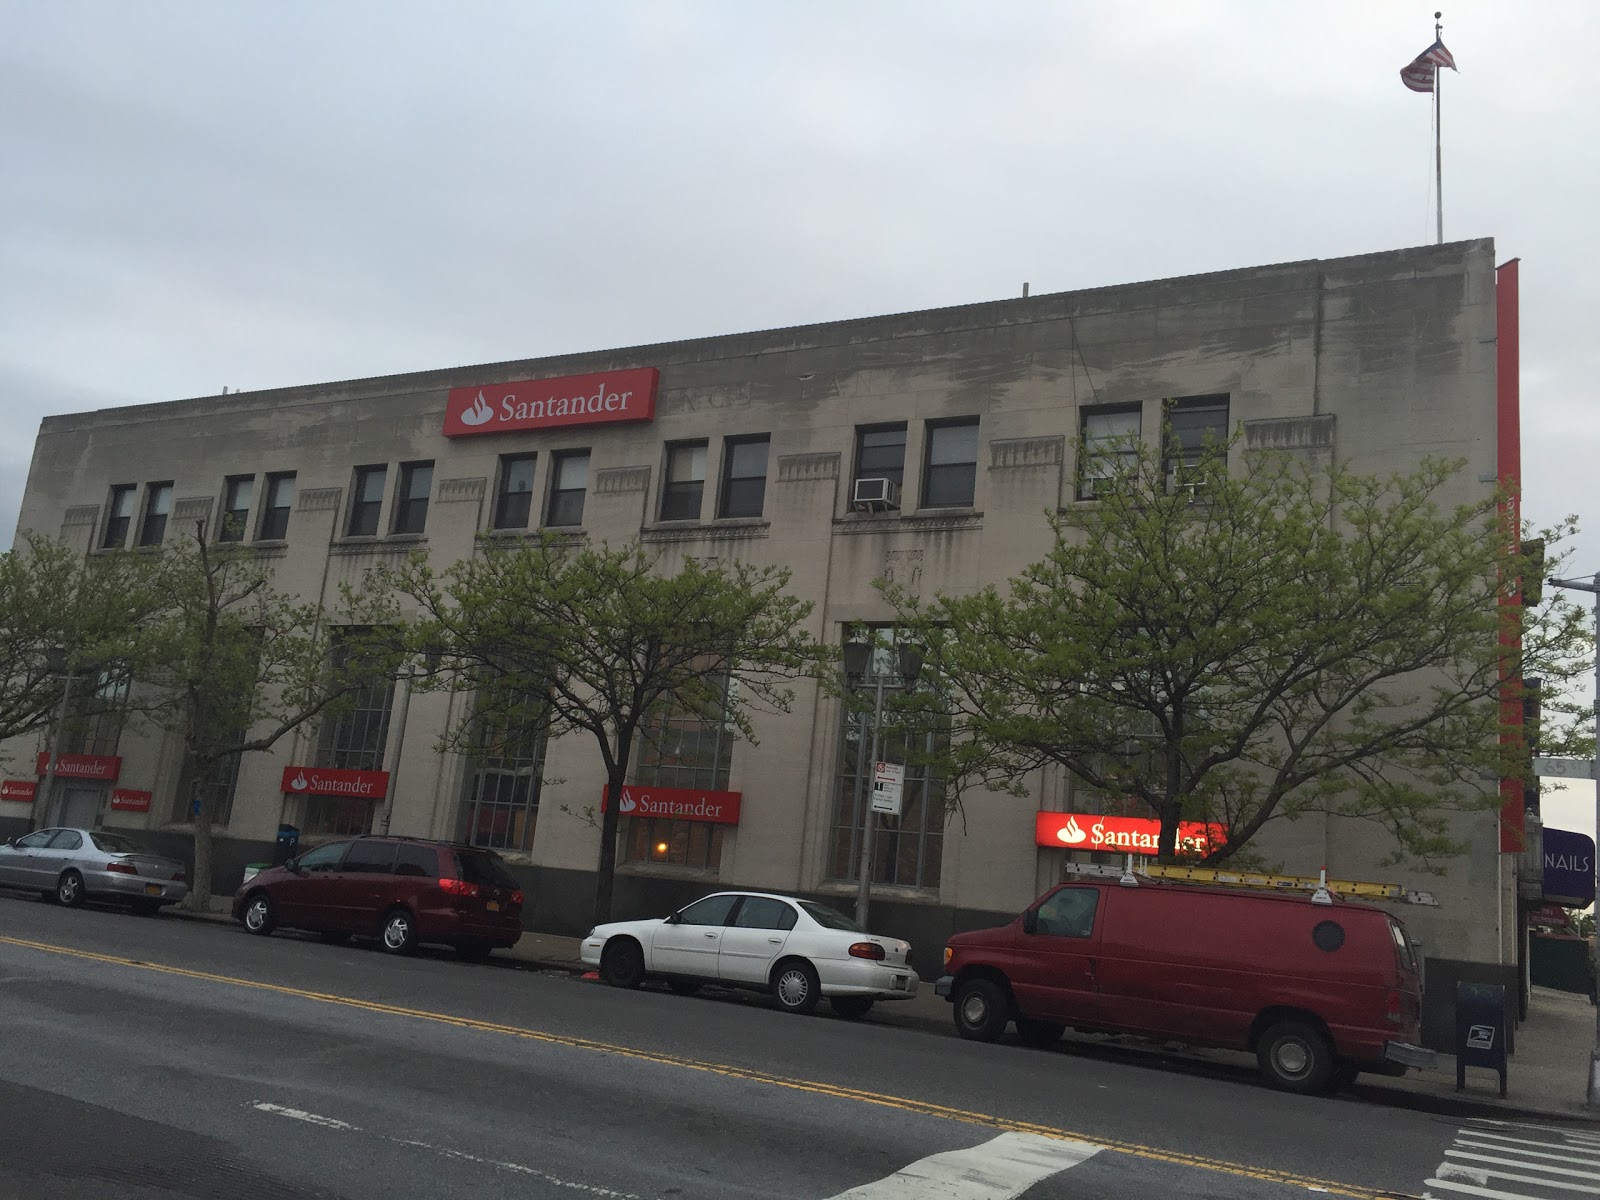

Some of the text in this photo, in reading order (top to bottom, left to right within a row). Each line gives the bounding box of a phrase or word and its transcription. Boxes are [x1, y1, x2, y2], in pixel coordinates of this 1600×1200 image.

[499, 382, 633, 422] Santander
[58, 758, 107, 775] Santander
[1544, 759, 1566, 774] 65
[8, 786, 33, 796] Santander
[310, 774, 374, 794] Santander
[639, 794, 723, 817] Santander
[1544, 852, 1589, 872] NAILS
